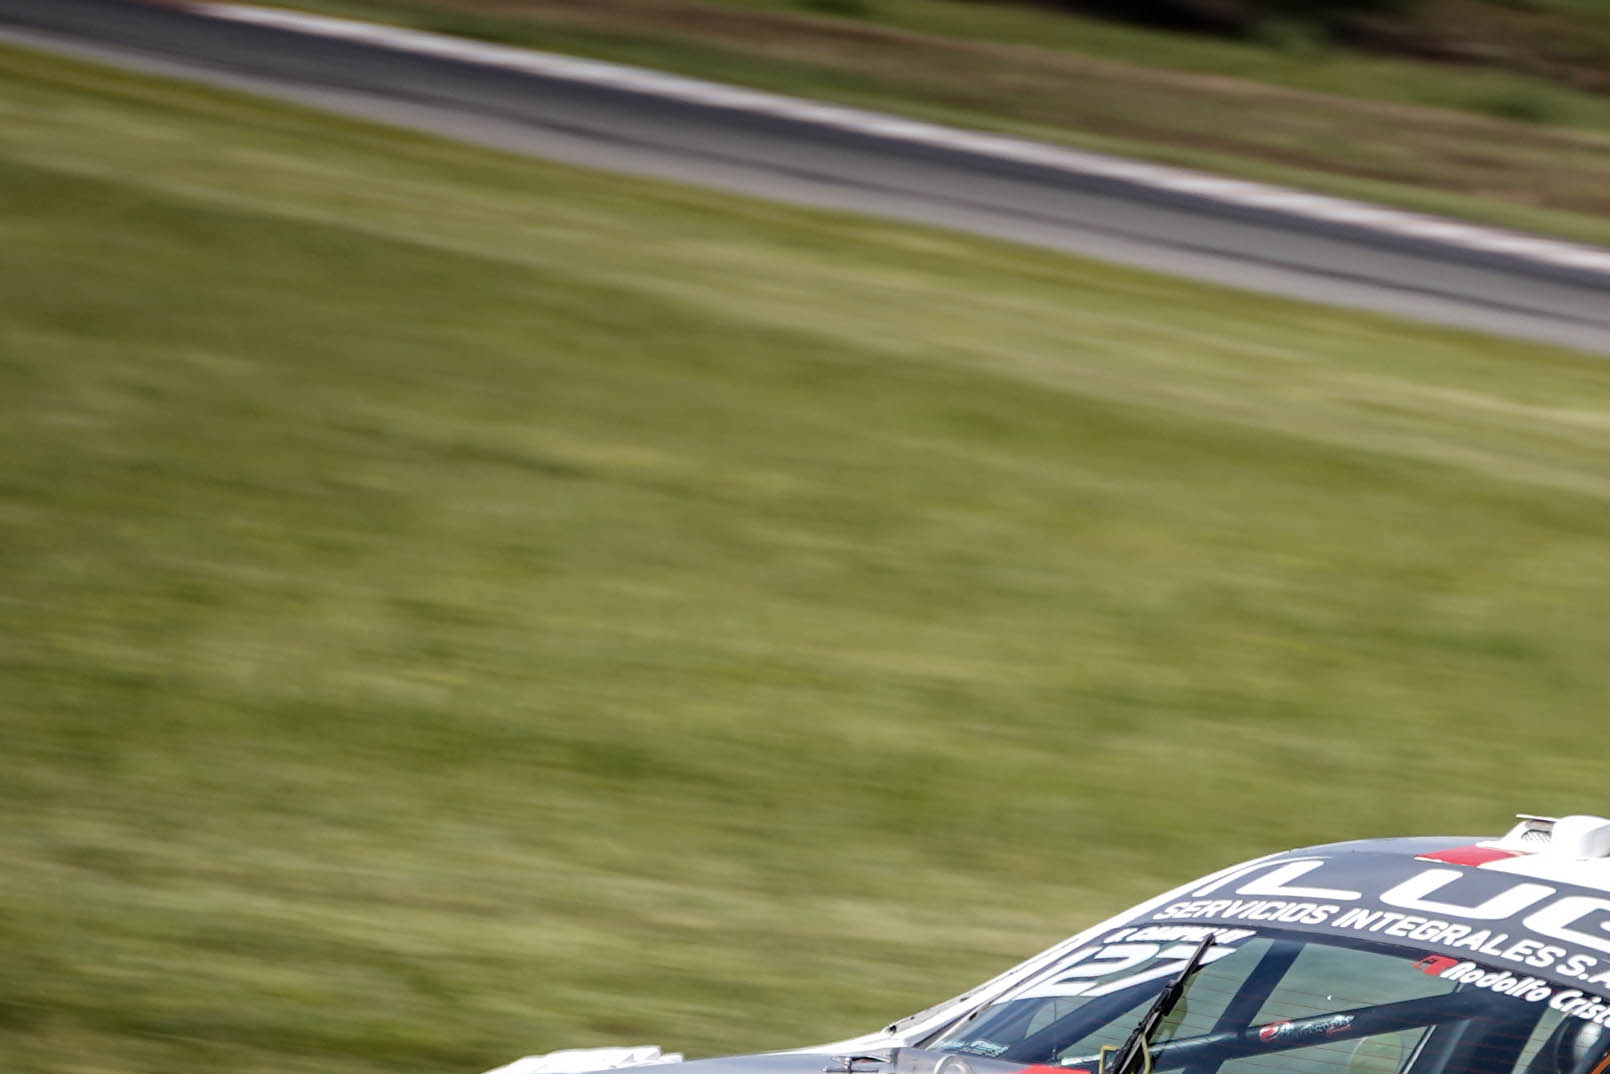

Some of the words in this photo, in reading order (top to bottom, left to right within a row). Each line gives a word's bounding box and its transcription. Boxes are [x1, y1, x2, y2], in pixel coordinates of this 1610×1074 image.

[1152, 900, 1340, 925] SERVICIOS
[1337, 906, 1568, 968] INTEGRALES
[1438, 961, 1552, 1003] Rodolfo
